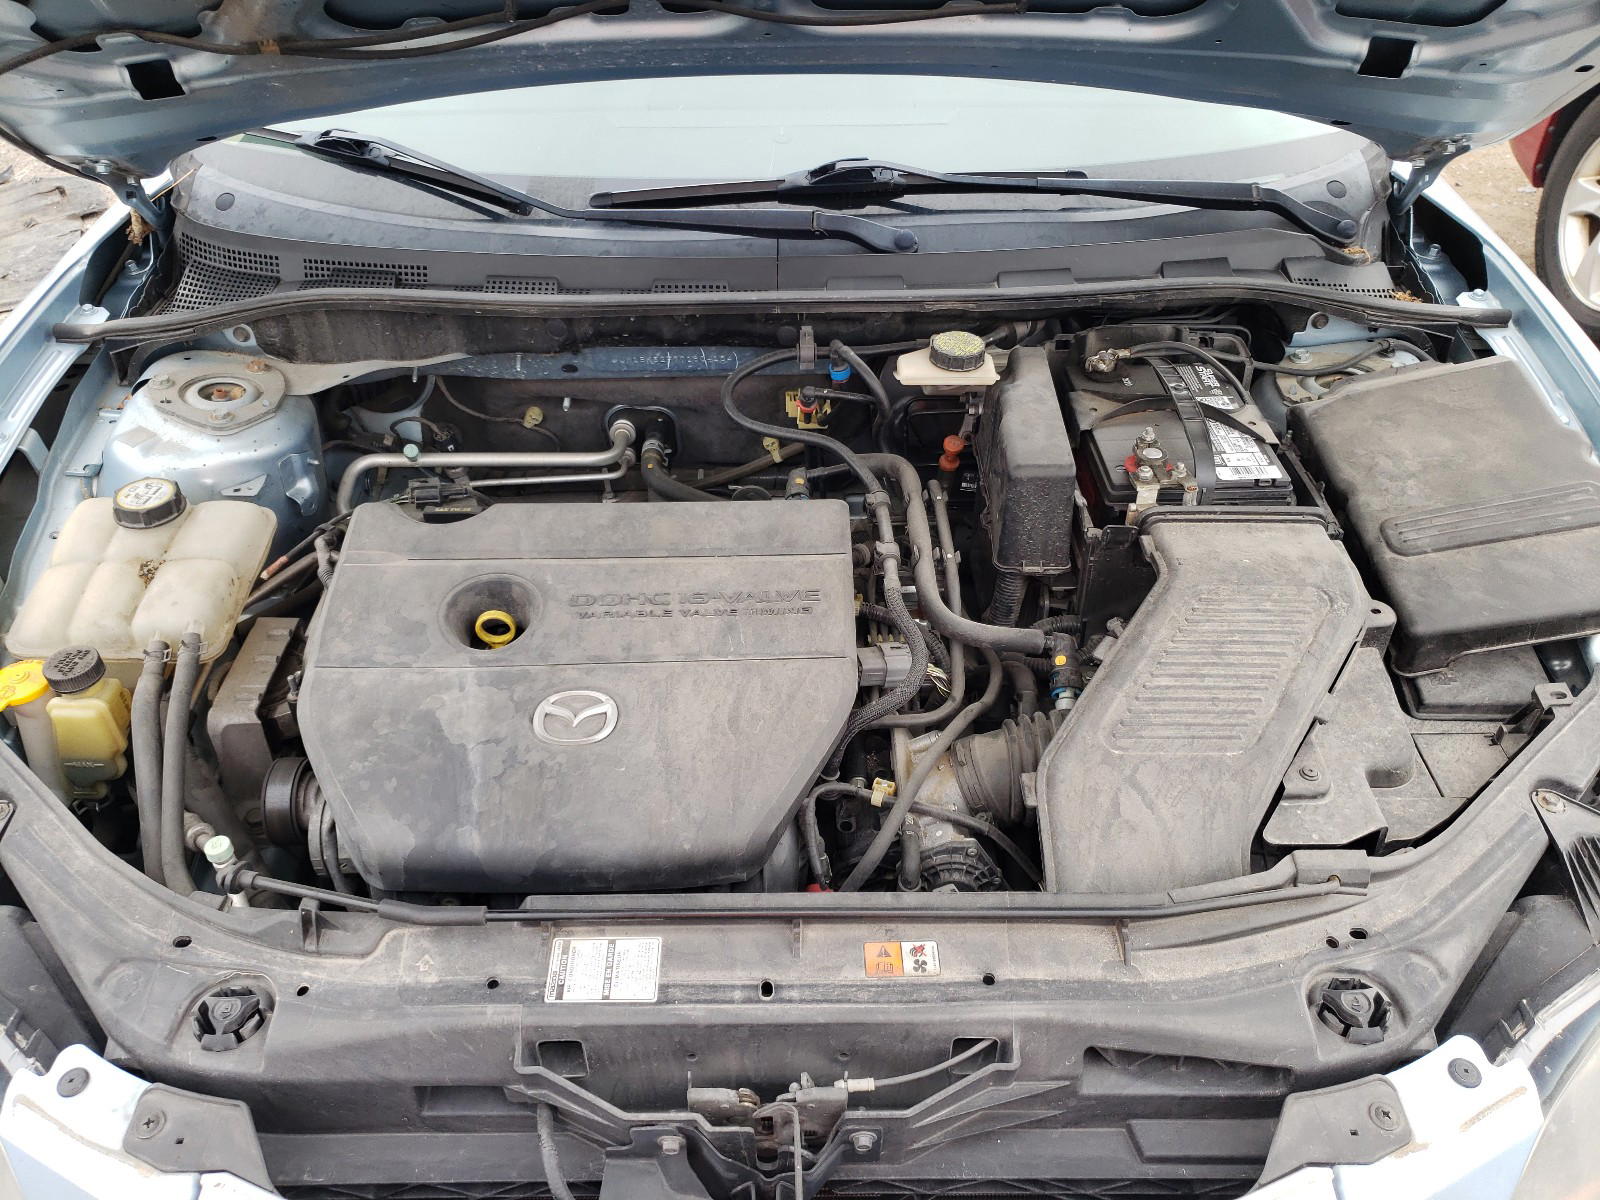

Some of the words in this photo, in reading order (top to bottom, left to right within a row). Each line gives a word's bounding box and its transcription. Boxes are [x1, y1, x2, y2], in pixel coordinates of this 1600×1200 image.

[569, 592, 671, 607] DOHC
[678, 590, 821, 605] 16-VALVE
[576, 609, 673, 620] VARIABLE
[679, 608, 738, 618] VALVE
[744, 606, 814, 616] TIMING
[607, 943, 616, 967] GARDE
[558, 954, 569, 985] CAUTION
[549, 970, 559, 998] mazda
[603, 979, 612, 996] MISE
